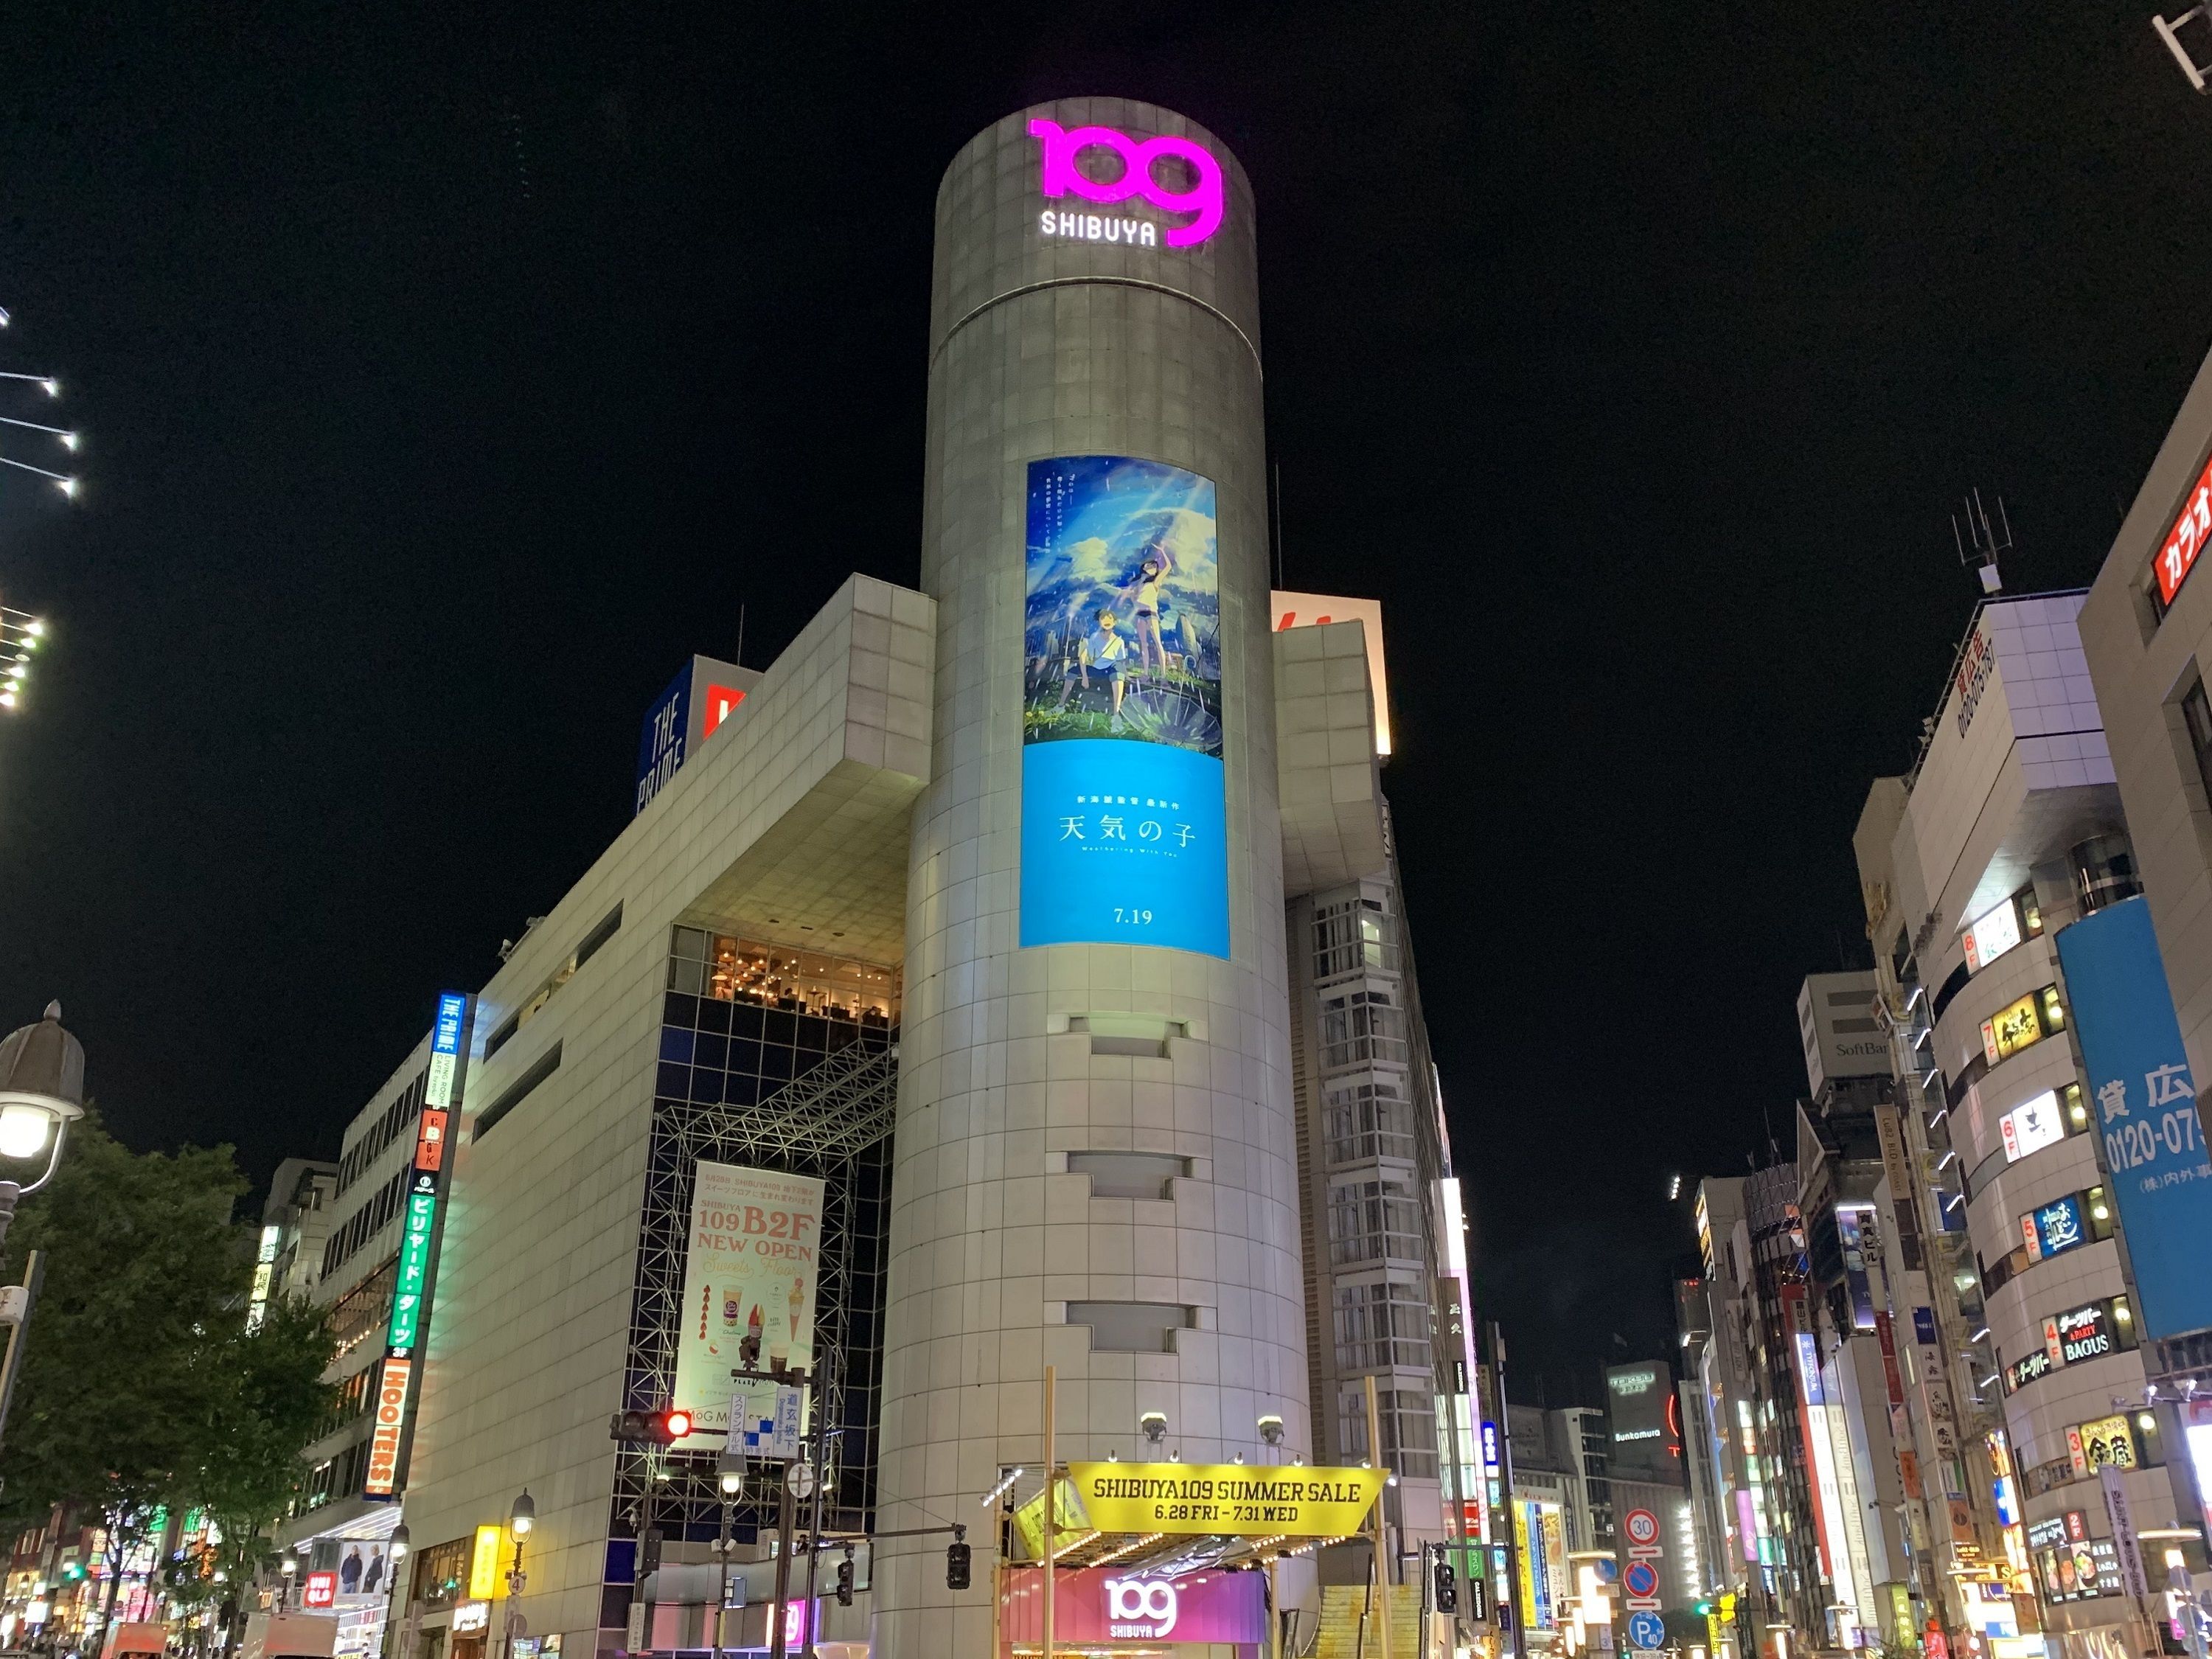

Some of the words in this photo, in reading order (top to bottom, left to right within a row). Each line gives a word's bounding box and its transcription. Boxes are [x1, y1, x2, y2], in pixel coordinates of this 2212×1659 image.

[1029, 118, 1223, 248] 109
[1041, 211, 1156, 246] SHIBUYA
[2165, 468, 2212, 588] カラオ
[653, 692, 679, 763] THE
[1060, 815, 1195, 848] 天気の子
[1114, 908, 1152, 925] 7.19
[442, 998, 461, 1018] THE
[437, 1018, 458, 1051] PRIME
[701, 1199, 741, 1212] SHIBUYA
[699, 1209, 740, 1231] 109
[742, 1206, 815, 1240] B2F
[698, 1232, 748, 1253] NEW
[754, 1239, 813, 1262] OPEN
[394, 1198, 431, 1344] ビリヤード・ダーツ
[392, 1347, 408, 1358] 3F
[2065, 1335, 2110, 1361] BAGUS
[370, 1371, 407, 1483] HOOTERS
[731, 1396, 743, 1452] スクランブル式
[784, 1394, 798, 1451] 道玄坂下
[1615, 1429, 1660, 1441] Bunkamura
[1093, 1478, 1213, 1500] SHIBUYA109
[1217, 1481, 1304, 1501] SUMMER
[1307, 1482, 1361, 1503] SALE
[1154, 1505, 1188, 1520] 6.28
[1191, 1505, 1219, 1520] FRI
[1233, 1506, 1260, 1521] 7.31
[1263, 1506, 1298, 1522] WED
[1633, 1520, 1652, 1535] 30
[310, 1576, 331, 1589] UNI
[512, 1579, 520, 1591] 4
[307, 1590, 331, 1604] QLO
[1105, 1581, 1177, 1638] 109
[1110, 1625, 1152, 1638] SHIBUYA
[1637, 1621, 1650, 1644] P
[1648, 1634, 1658, 1644] 40
